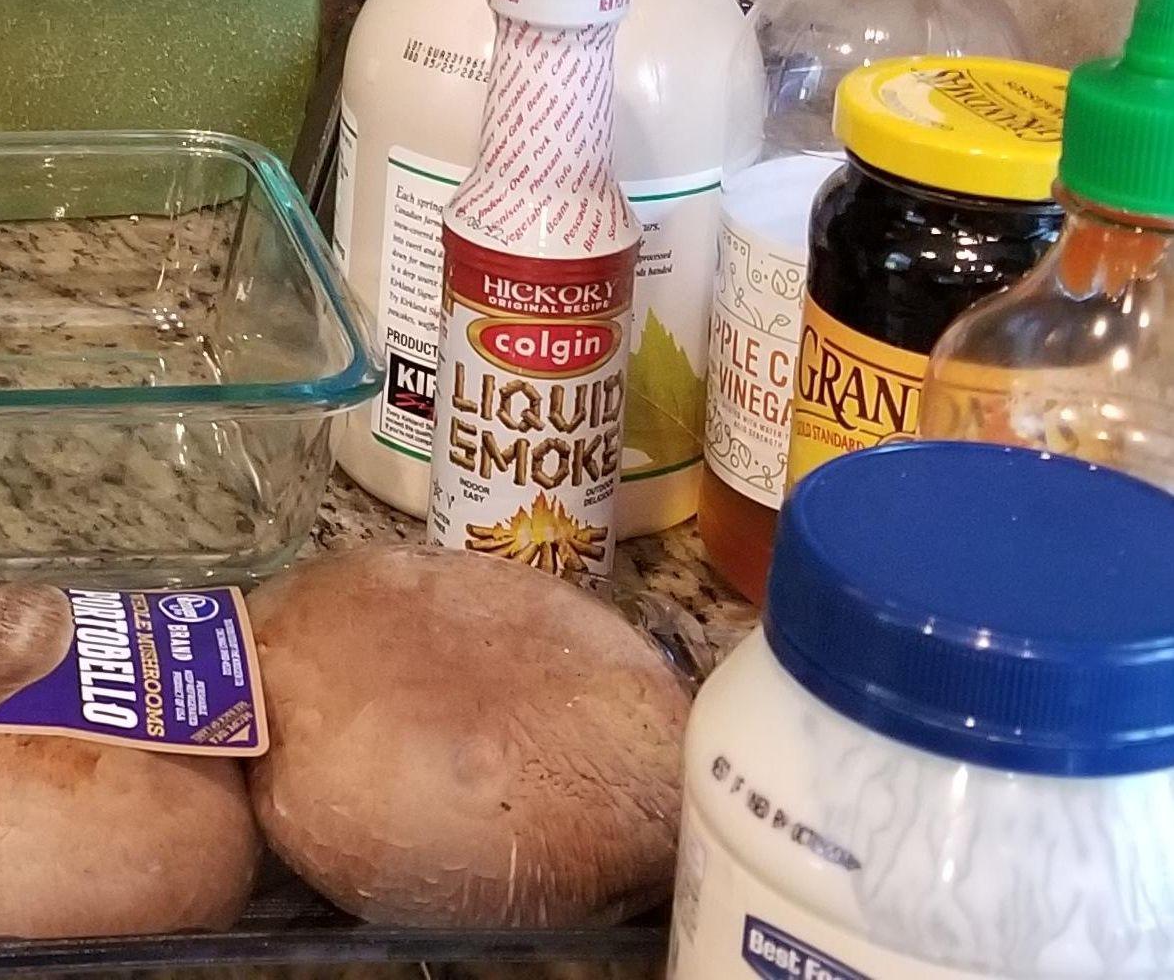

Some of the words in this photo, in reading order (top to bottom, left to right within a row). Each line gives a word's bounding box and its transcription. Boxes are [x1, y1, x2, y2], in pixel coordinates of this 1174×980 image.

[527, 82, 548, 113] Beans
[551, 45, 571, 75] Carne
[499, 140, 526, 177] Chicken
[529, 95, 559, 137] Pescado
[510, 165, 530, 191] Oven
[533, 137, 552, 161] Pork
[554, 93, 578, 132] Brisket
[529, 148, 563, 195] Pheasant
[566, 111, 585, 143] Game
[396, 185, 415, 204] Each
[417, 198, 443, 215] spring
[500, 194, 553, 247] Vegetables
[555, 164, 573, 189] Tofu
[546, 200, 570, 235] Beans
[571, 160, 590, 194] Carne
[563, 198, 589, 245] Pescado
[583, 209, 603, 253] Brisket
[484, 274, 617, 305] HICKORY
[488, 296, 558, 314] ORIGINAL
[564, 300, 610, 314] RECIPE
[387, 327, 438, 357] PRODUCT
[495, 330, 601, 365] colgin
[452, 361, 623, 434] LIQUID
[798, 324, 922, 434] GRAN
[449, 416, 621, 490] SMOKE
[748, 428, 783, 448] STRENGTH
[760, 423, 782, 438] WATER
[811, 424, 865, 453] STANDARD
[459, 477, 490, 495] INDOOR
[463, 490, 485, 504] EASY
[69, 588, 139, 729] PORTOBELLO
[167, 624, 193, 661] BRAND
[136, 631, 165, 738] MUSHROOMS
[749, 928, 801, 976] Best
